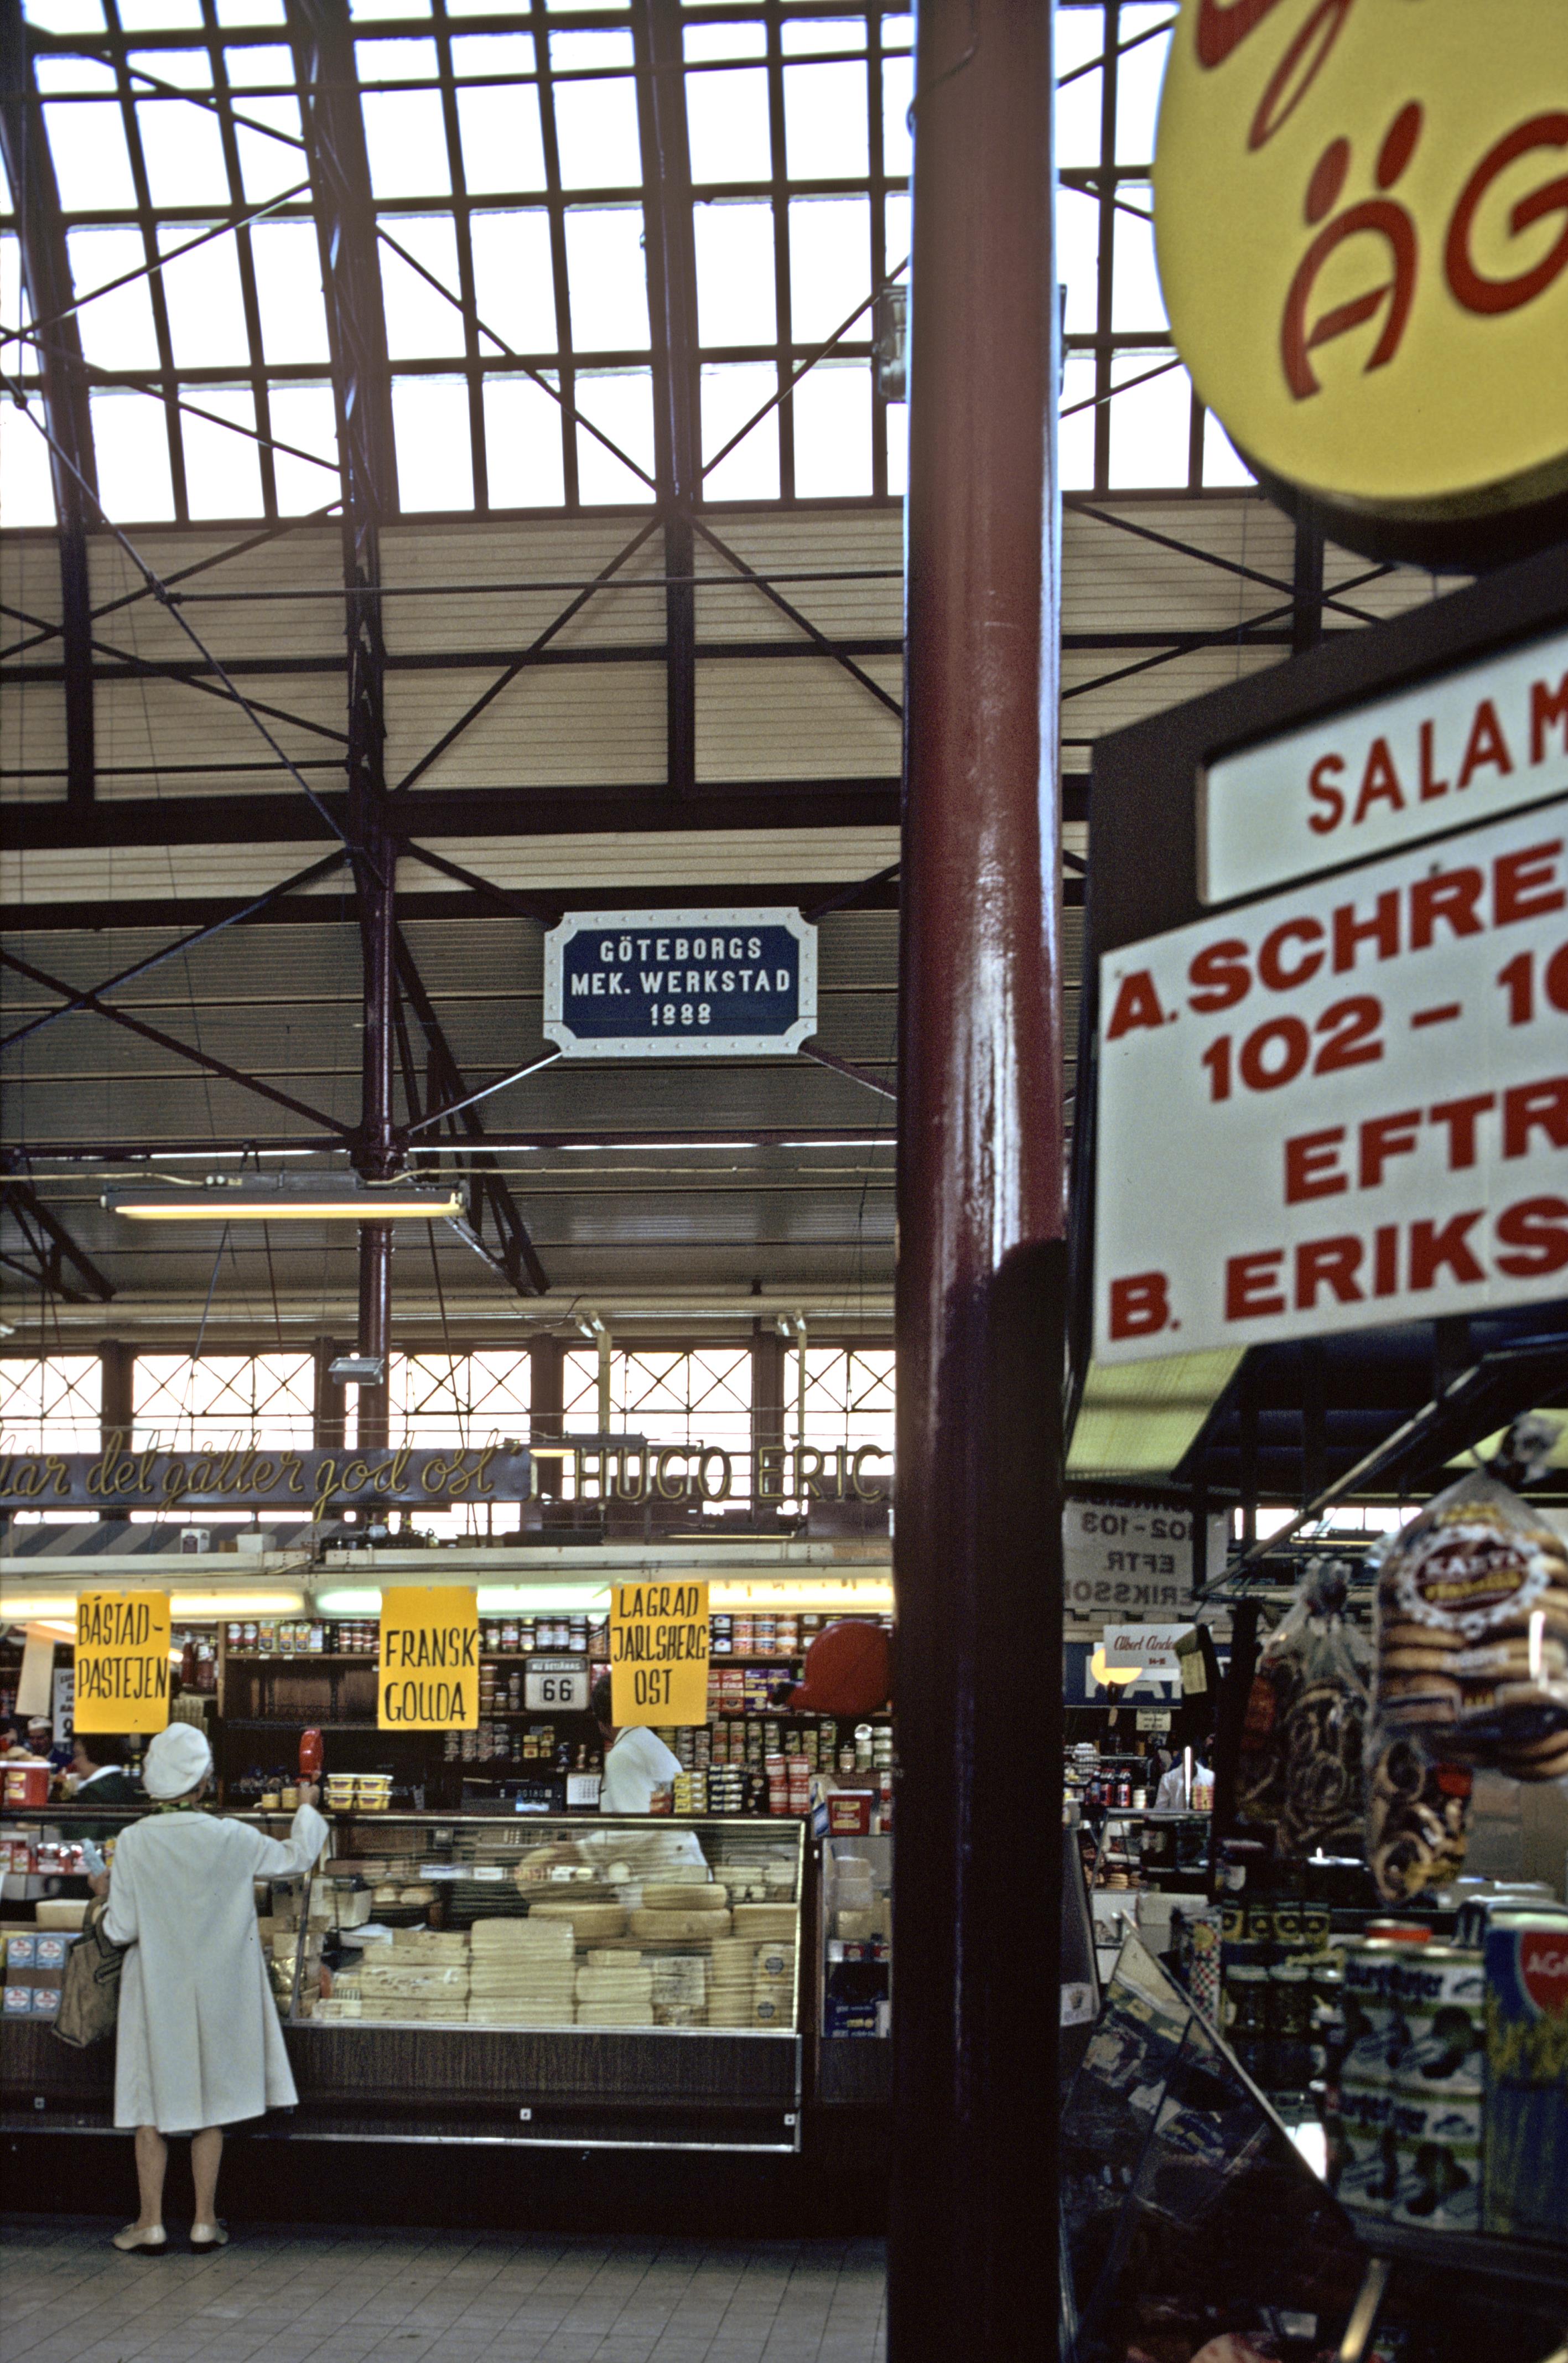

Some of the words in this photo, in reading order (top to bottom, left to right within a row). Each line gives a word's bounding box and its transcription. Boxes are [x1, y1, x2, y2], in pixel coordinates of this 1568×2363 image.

[600, 936, 762, 962] GÖTEBORGS
[571, 972, 631, 995] MEK.
[640, 970, 790, 994] WERKSTAD
[651, 1003, 712, 1026] 1888
[1201, 994, 1383, 1103] 102
[1285, 1075, 1568, 1207] EFTR
[1109, 1271, 1181, 1342] B.
[1224, 1194, 1568, 1323] ERIKS
[86, 1430, 175, 1495] det
[157, 1430, 303, 1522] gäller
[311, 1430, 413, 1522] god
[421, 1427, 521, 1495] ost
[574, 1445, 731, 1501] HUGO
[757, 1444, 884, 1502] ERIC
[619, 1587, 699, 1619] LAGRAD
[385, 1628, 477, 1668] FRANSK
[612, 1624, 707, 1662] JARLSBERG
[77, 1658, 167, 1699] PASTEJEN
[543, 1679, 572, 1702] 66
[634, 1668, 673, 1706] OST
[383, 1681, 467, 1722] GOUDA
